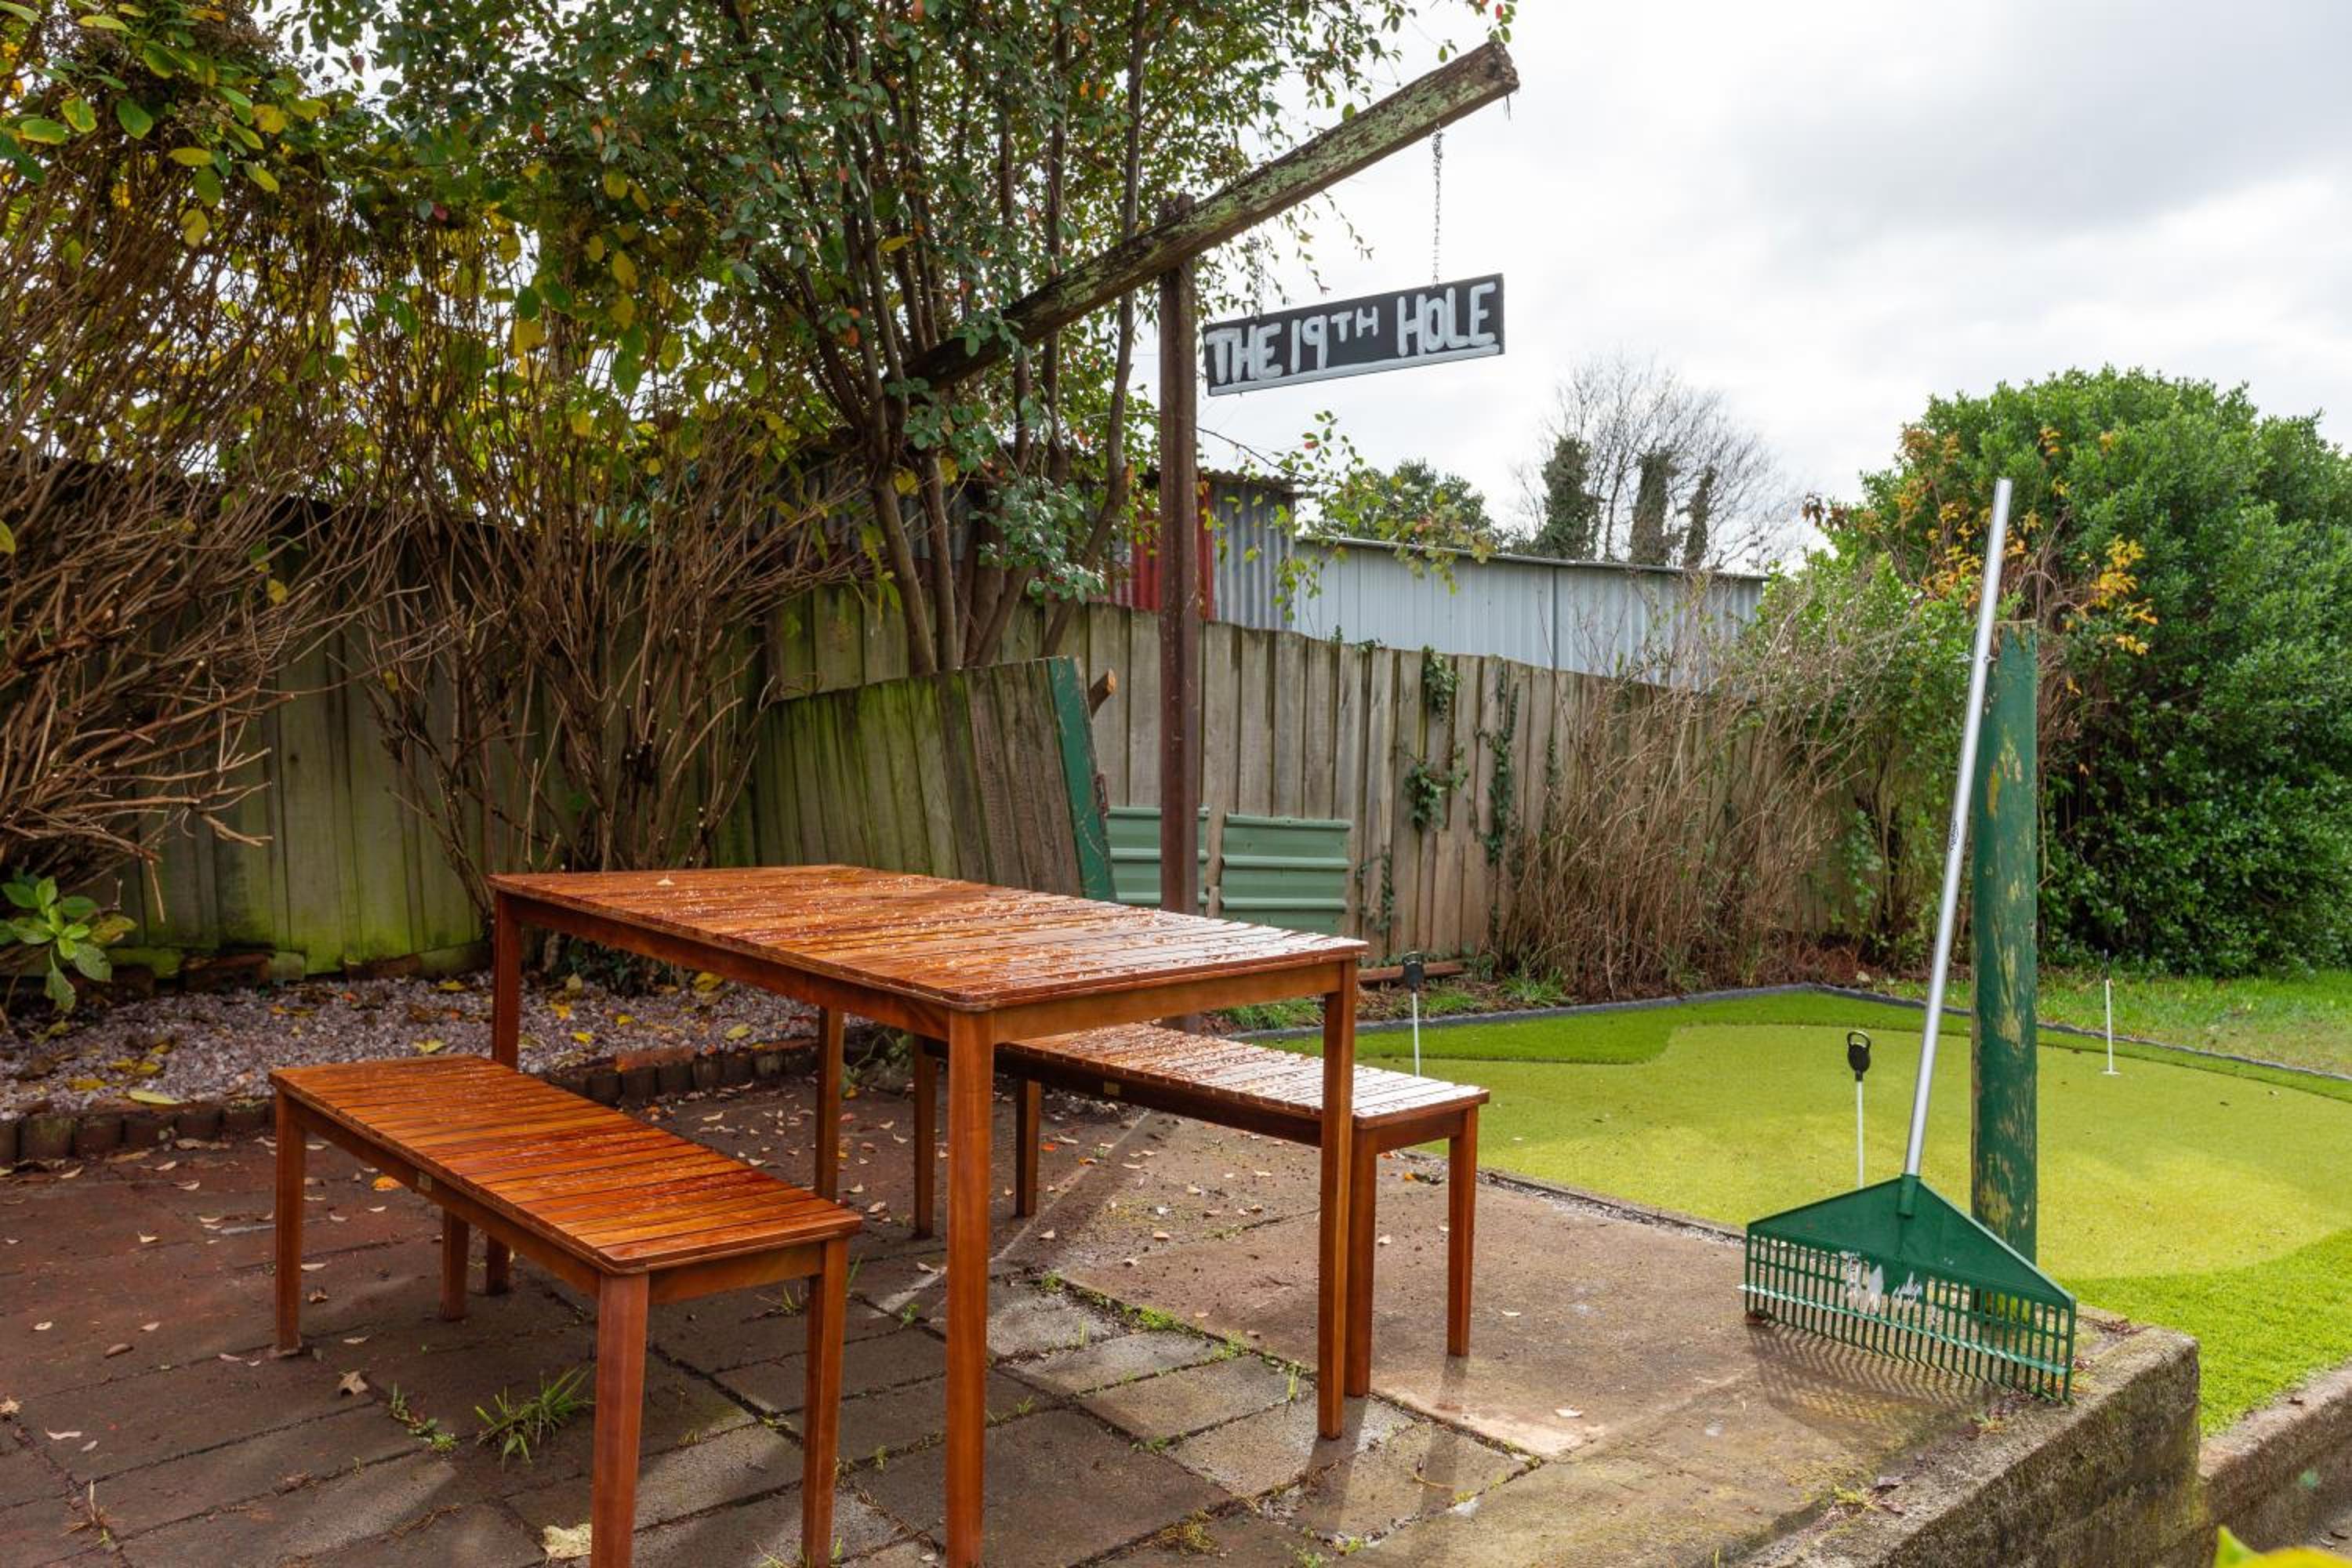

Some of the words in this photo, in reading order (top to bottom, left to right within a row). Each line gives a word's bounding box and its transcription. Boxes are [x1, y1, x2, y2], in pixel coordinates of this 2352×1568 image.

[1205, 322, 1283, 384] THE
[1290, 306, 1379, 374] 19TH
[1397, 281, 1497, 357] HOLE
